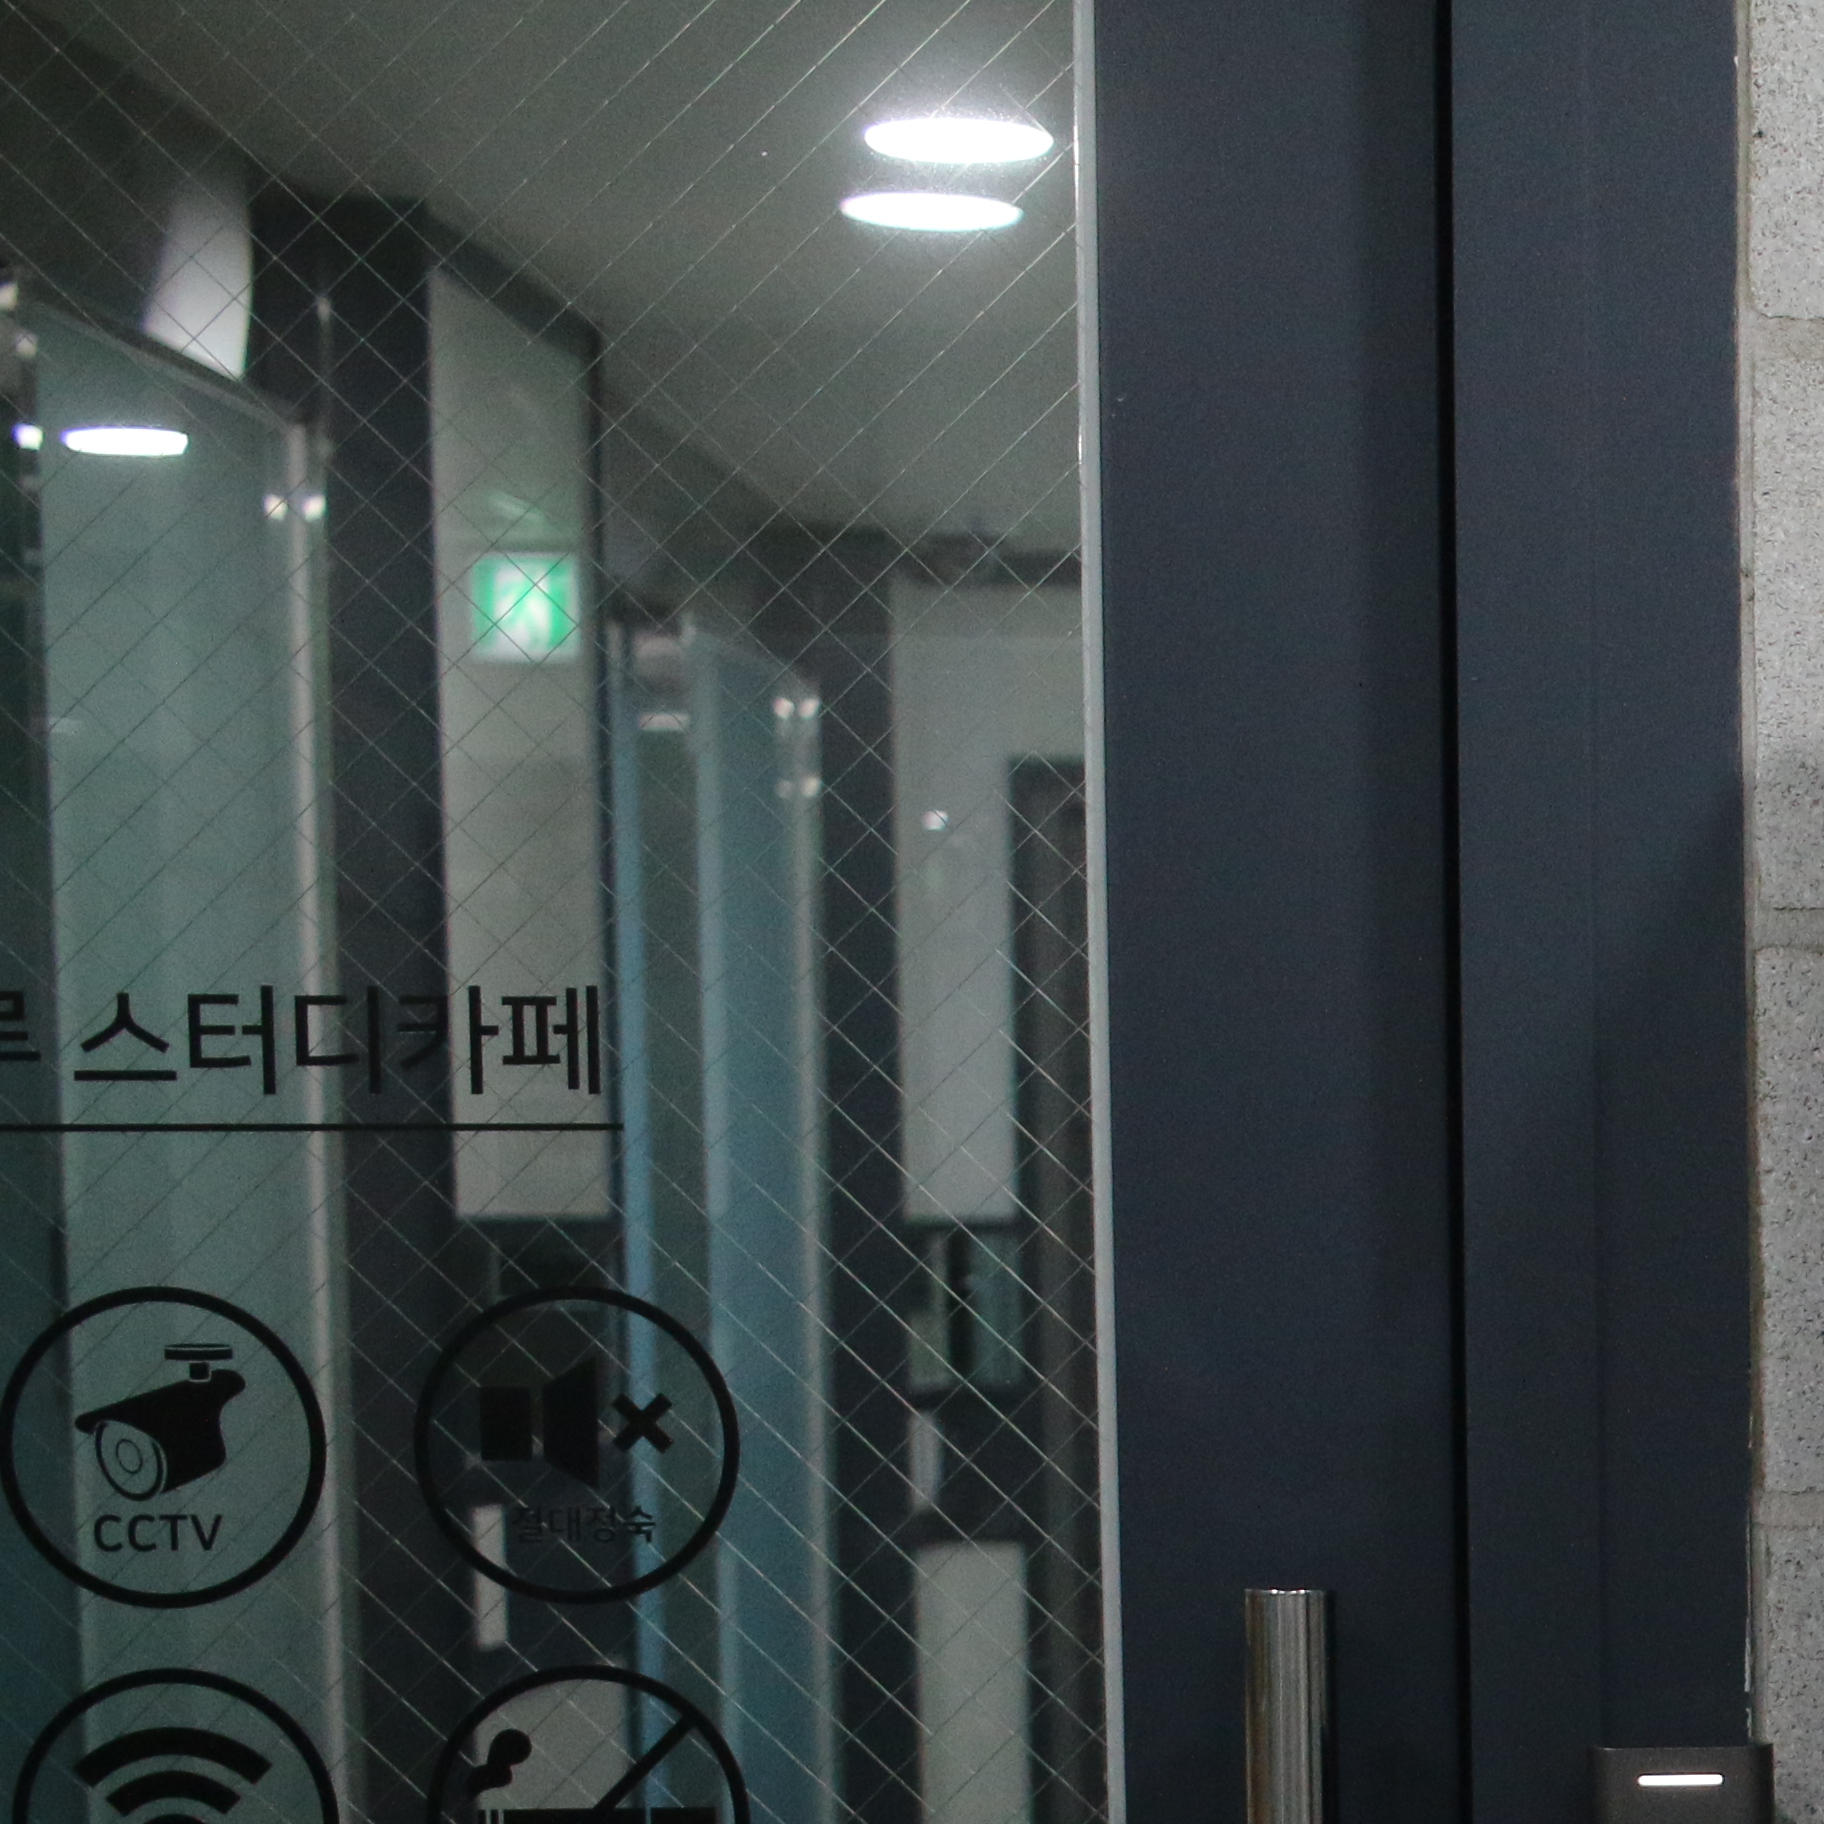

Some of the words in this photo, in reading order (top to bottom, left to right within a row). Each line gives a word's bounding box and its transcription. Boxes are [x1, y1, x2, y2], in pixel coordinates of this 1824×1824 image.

[74, 983, 601, 1095] 스터디카페
[93, 1512, 223, 1554] CCTV
[512, 1505, 656, 1543] 절대정숙
